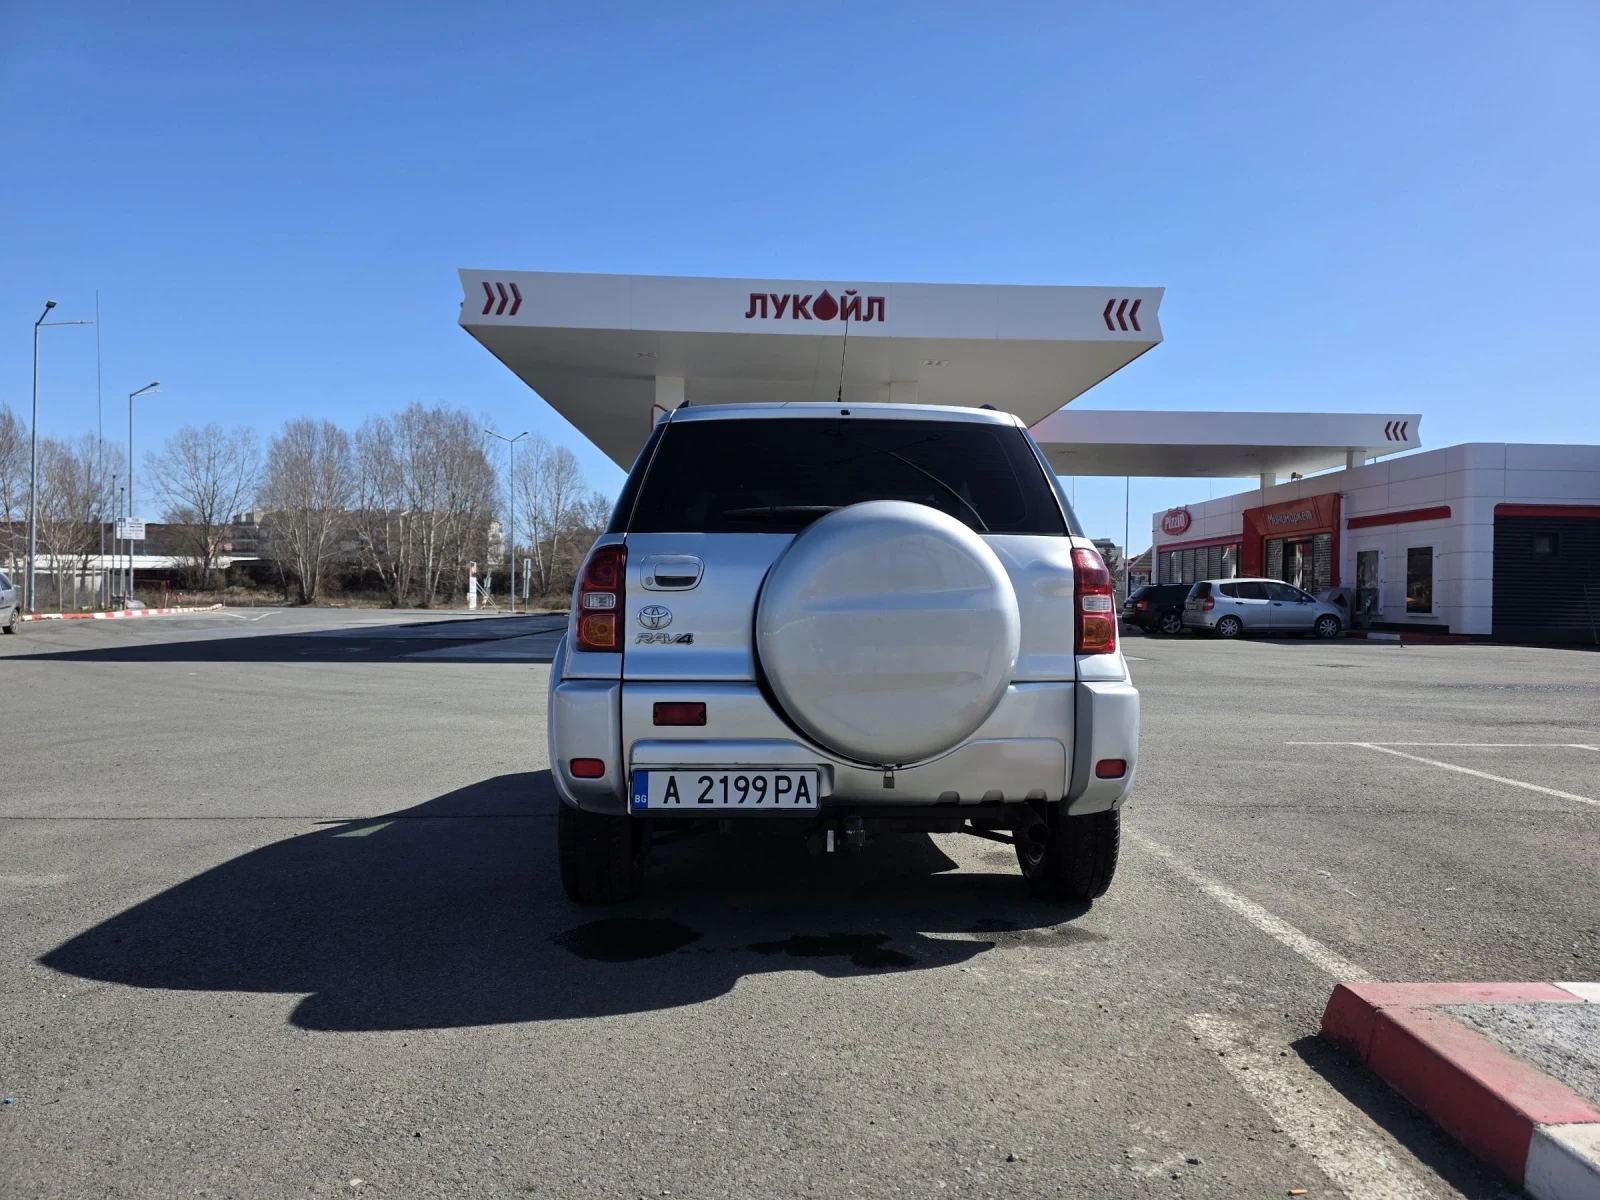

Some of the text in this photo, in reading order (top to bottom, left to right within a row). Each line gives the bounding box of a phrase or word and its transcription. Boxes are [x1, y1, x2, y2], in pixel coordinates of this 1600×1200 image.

[745, 289, 885, 321] ЛУКОЙЛ
[1267, 510, 1313, 526] Минимаркет
[635, 632, 695, 646] RAV4
[663, 775, 681, 804] A
[634, 794, 647, 804] BG
